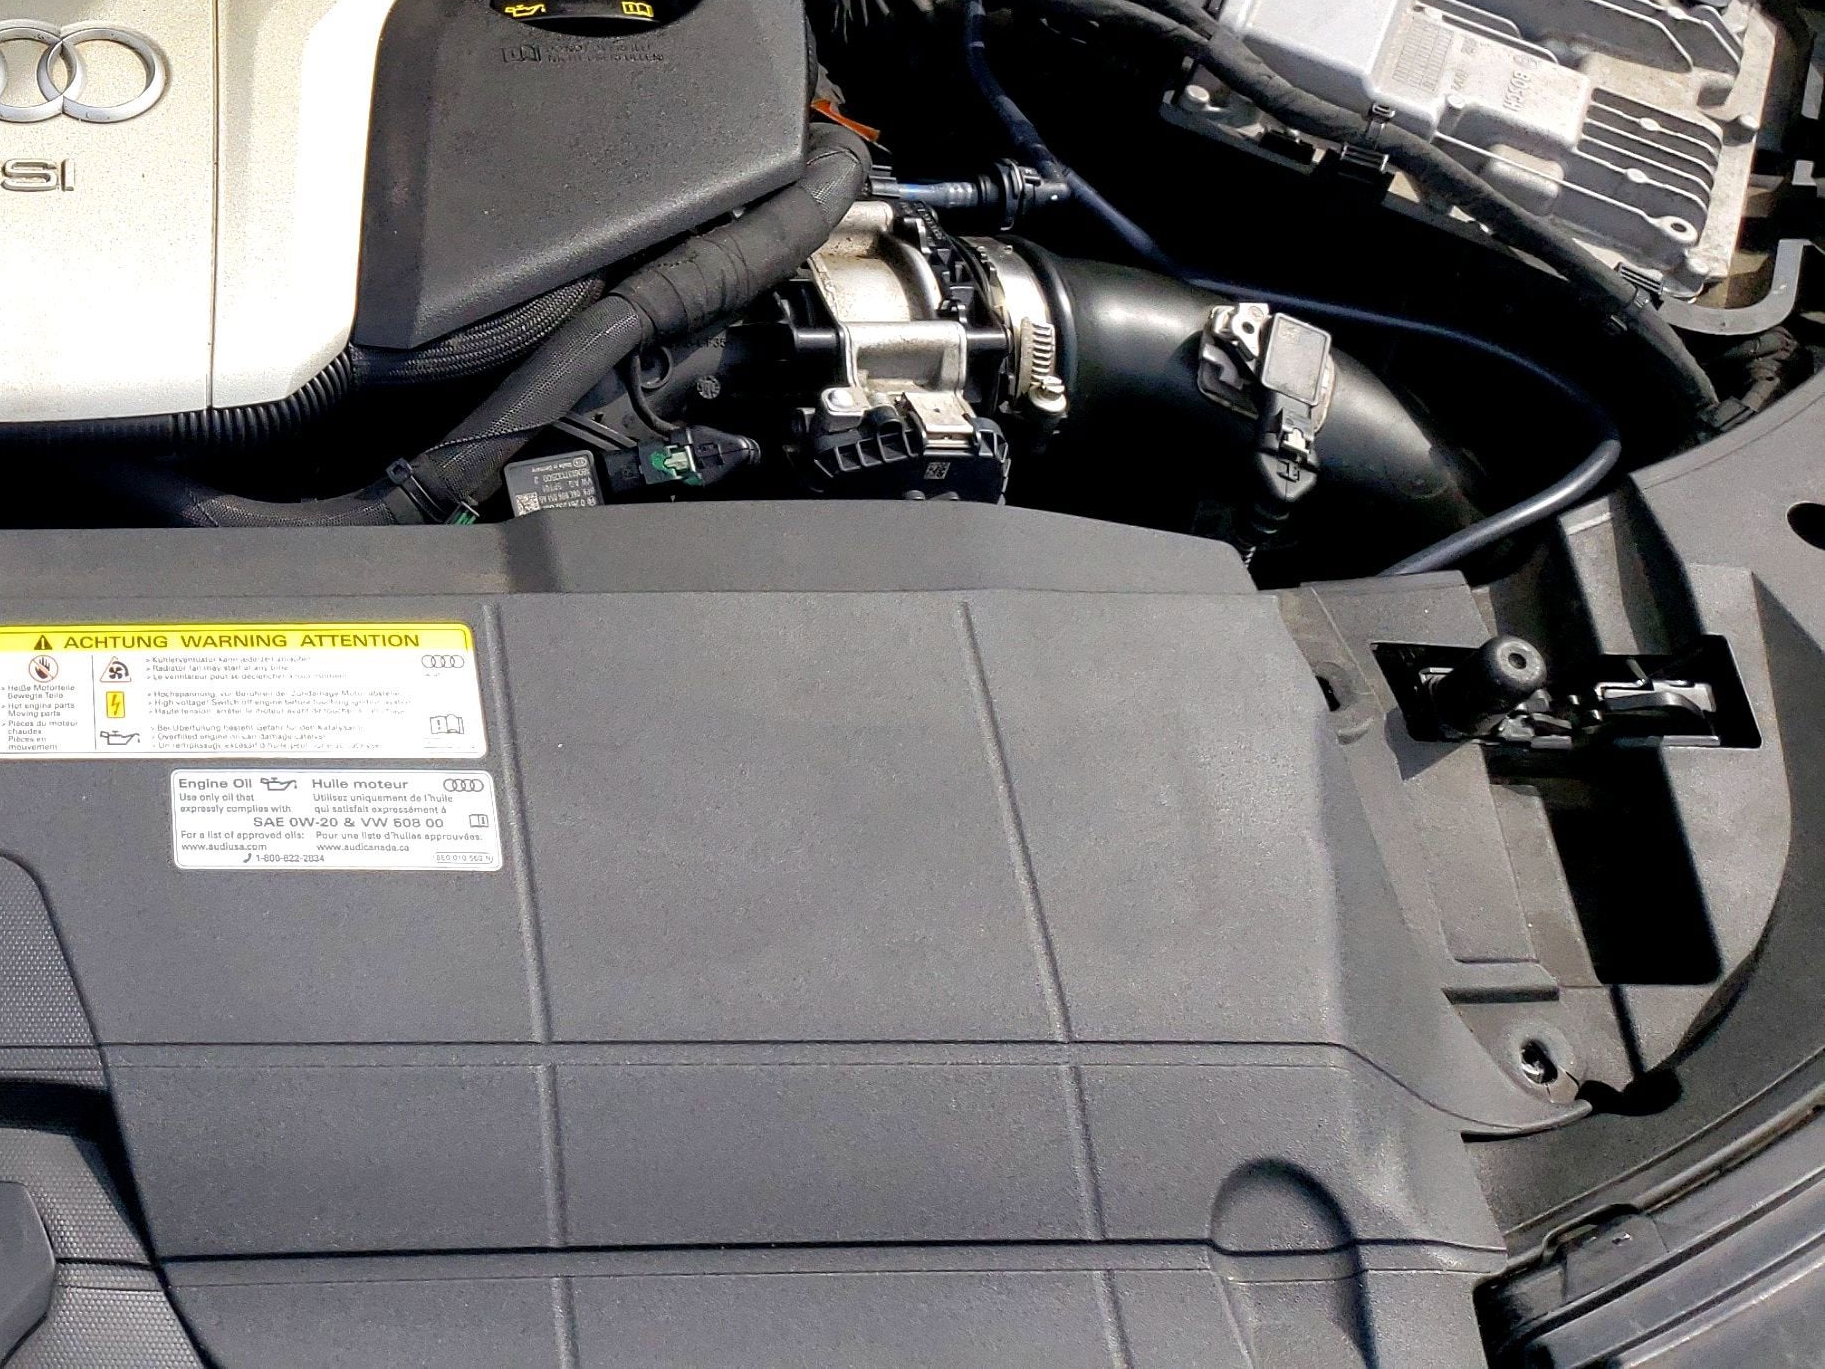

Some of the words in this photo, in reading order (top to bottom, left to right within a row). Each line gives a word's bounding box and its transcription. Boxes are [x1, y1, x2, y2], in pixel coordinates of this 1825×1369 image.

[1503, 70, 1531, 112] BOSCH
[64, 634, 168, 649] ACHTUNG
[181, 634, 288, 648] WARNING
[300, 634, 420, 648] ATTENTION
[179, 778, 228, 790] Engine
[233, 778, 252, 788] Oil
[312, 779, 348, 789] Huile
[353, 780, 408, 789] moteur
[179, 793, 197, 801] Use
[199, 793, 219, 802] only
[222, 793, 233, 801] oil
[236, 793, 254, 801] that
[313, 794, 348, 802] Utilisez
[350, 794, 408, 803] uniquement
[410, 794, 421, 802] de
[181, 805, 224, 814] expressly
[227, 805, 268, 814] complies
[271, 805, 291, 813] with
[314, 806, 329, 814] qui
[332, 805, 369, 813] satisfait
[254, 817, 284, 827] SAE
[289, 817, 339, 828] 0W-20
[344, 818, 355, 827] &
[361, 817, 388, 827] VW
[426, 818, 444, 828] 00
[181, 831, 196, 839] For
[208, 831, 221, 839] list
[224, 831, 234, 839] of
[237, 831, 281, 840] approved
[285, 831, 304, 839] oils:
[316, 831, 338, 839] Pour
[361, 831, 381, 839] liste
[182, 843, 267, 851] www.audiusa.com
[316, 843, 409, 851] www.audicanada.ca
